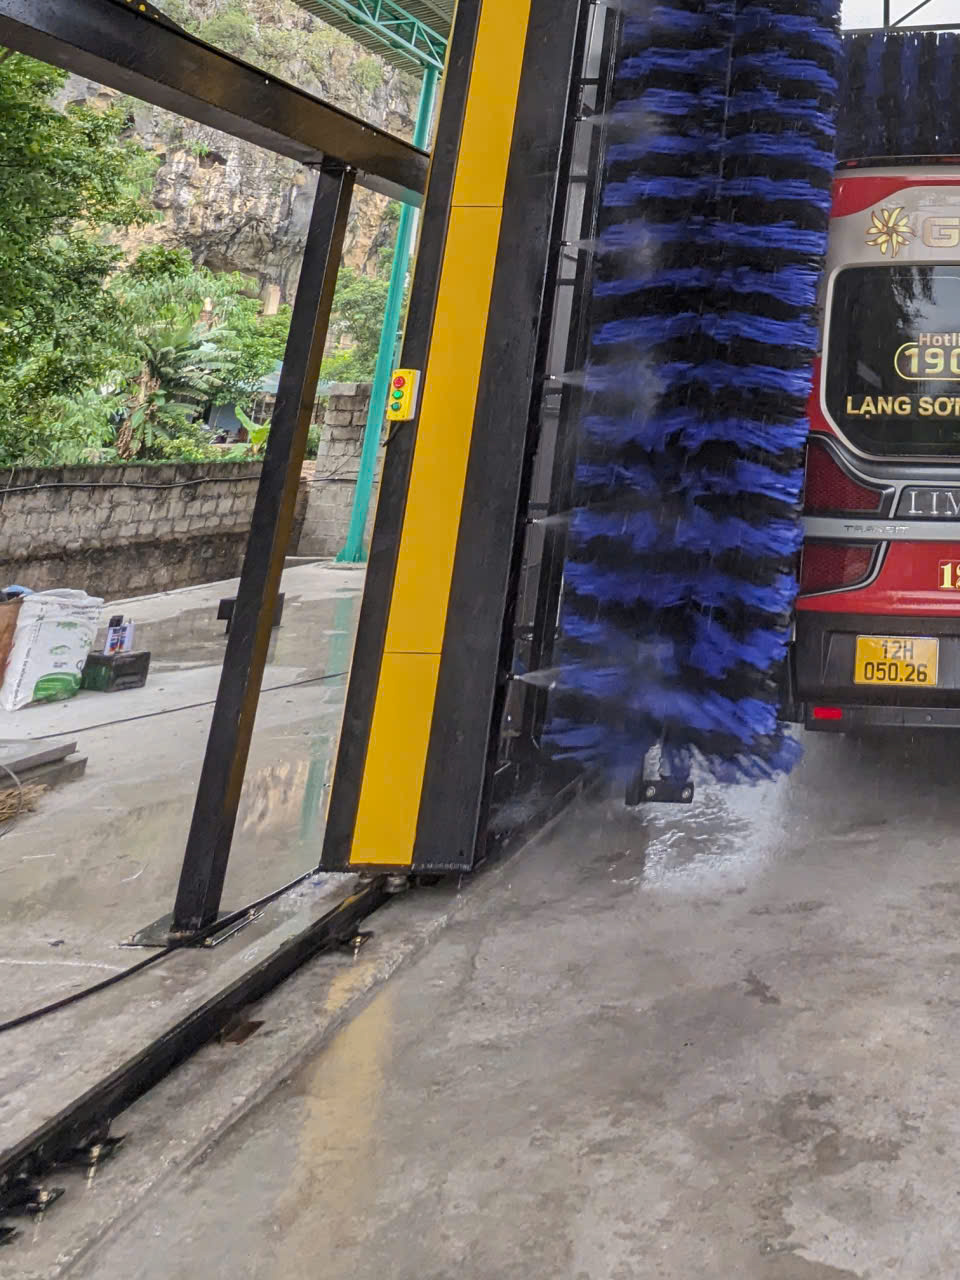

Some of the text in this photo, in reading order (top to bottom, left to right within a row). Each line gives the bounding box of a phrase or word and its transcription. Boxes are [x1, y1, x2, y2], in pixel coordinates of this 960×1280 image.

[847, 396, 911, 420] LẠNG
[882, 639, 913, 660] 12H
[864, 661, 928, 683] 050.26
